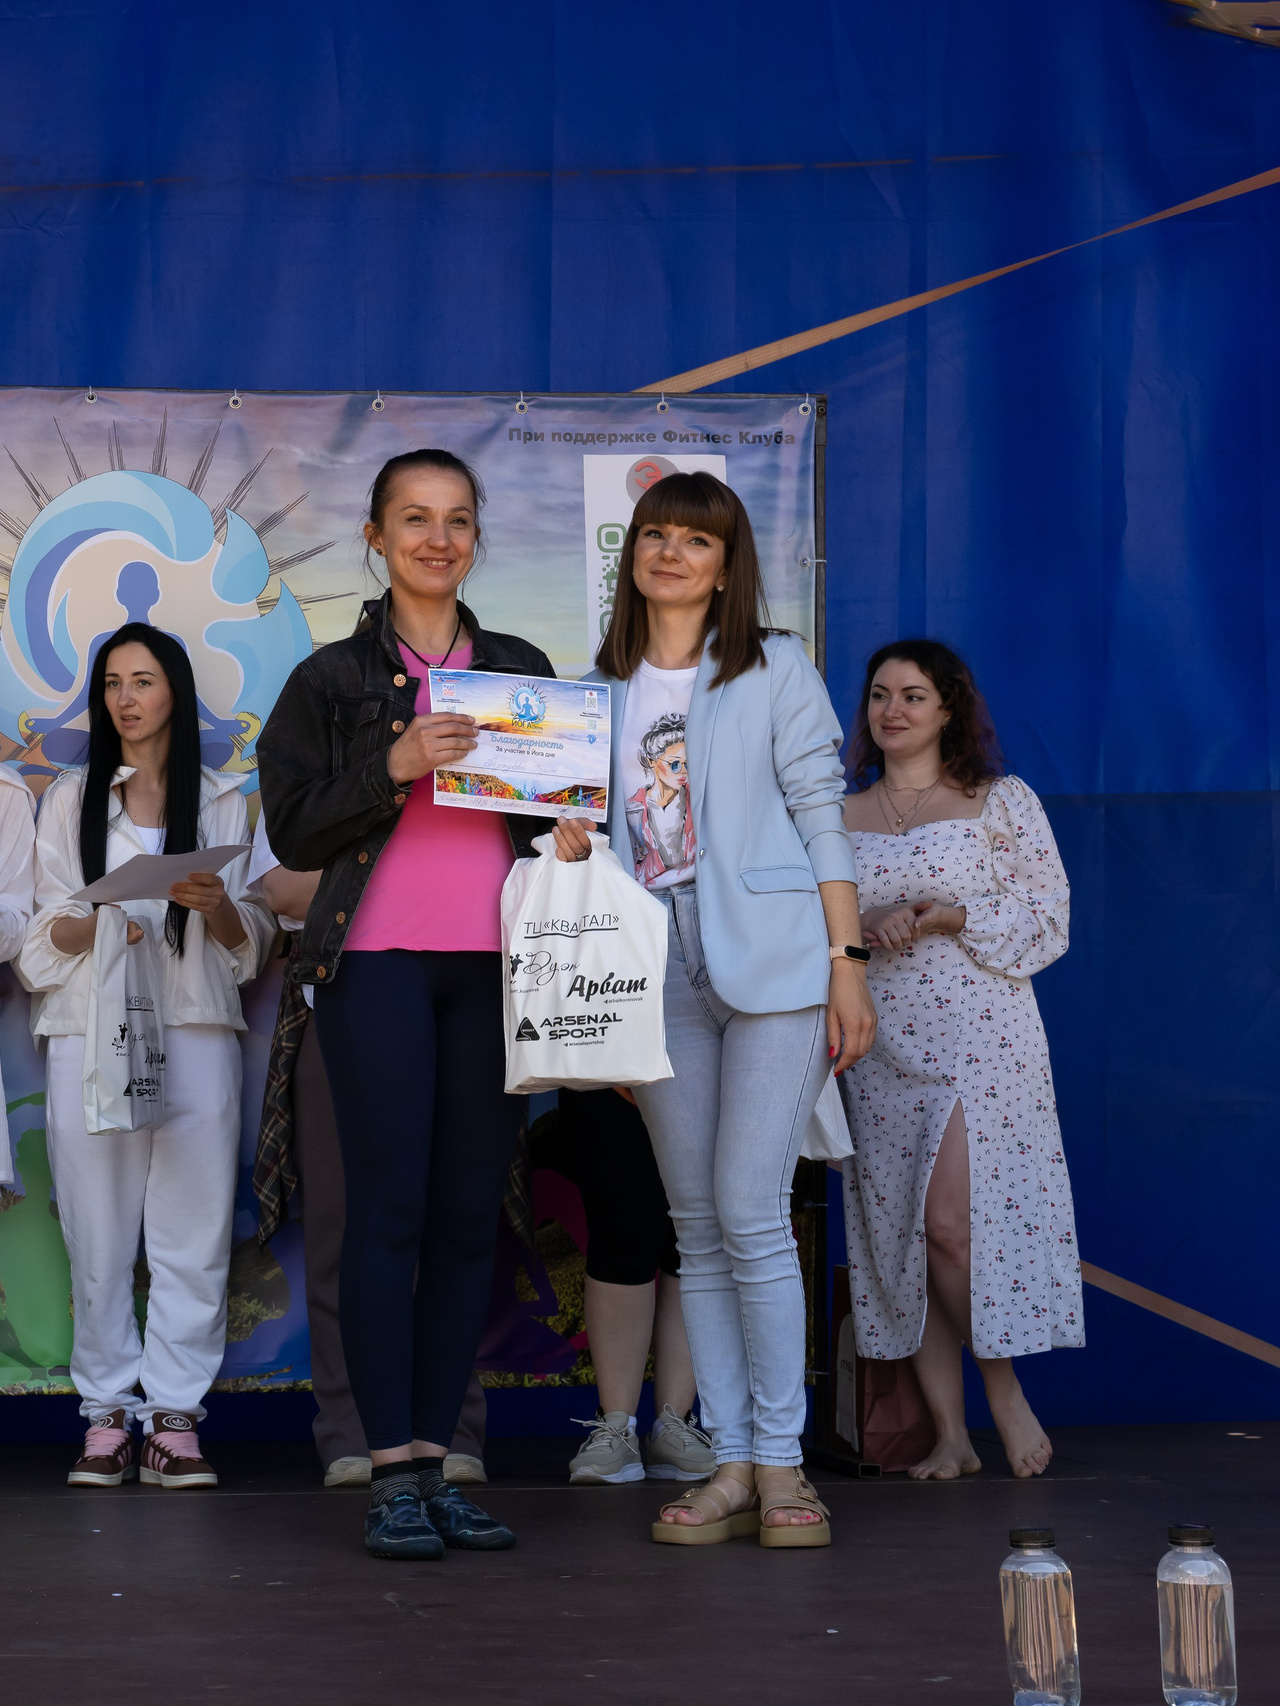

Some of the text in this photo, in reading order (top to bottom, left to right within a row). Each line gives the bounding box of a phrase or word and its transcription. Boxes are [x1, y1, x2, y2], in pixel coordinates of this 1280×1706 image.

[508, 428, 796, 448] При поддержке Фитнес Клуба
[489, 732, 564, 751] Благодарность
[504, 747, 526, 755] участие
[566, 971, 648, 1003] Арбат
[539, 1012, 624, 1028] ARSENAL
[548, 1026, 608, 1041] SPORT
